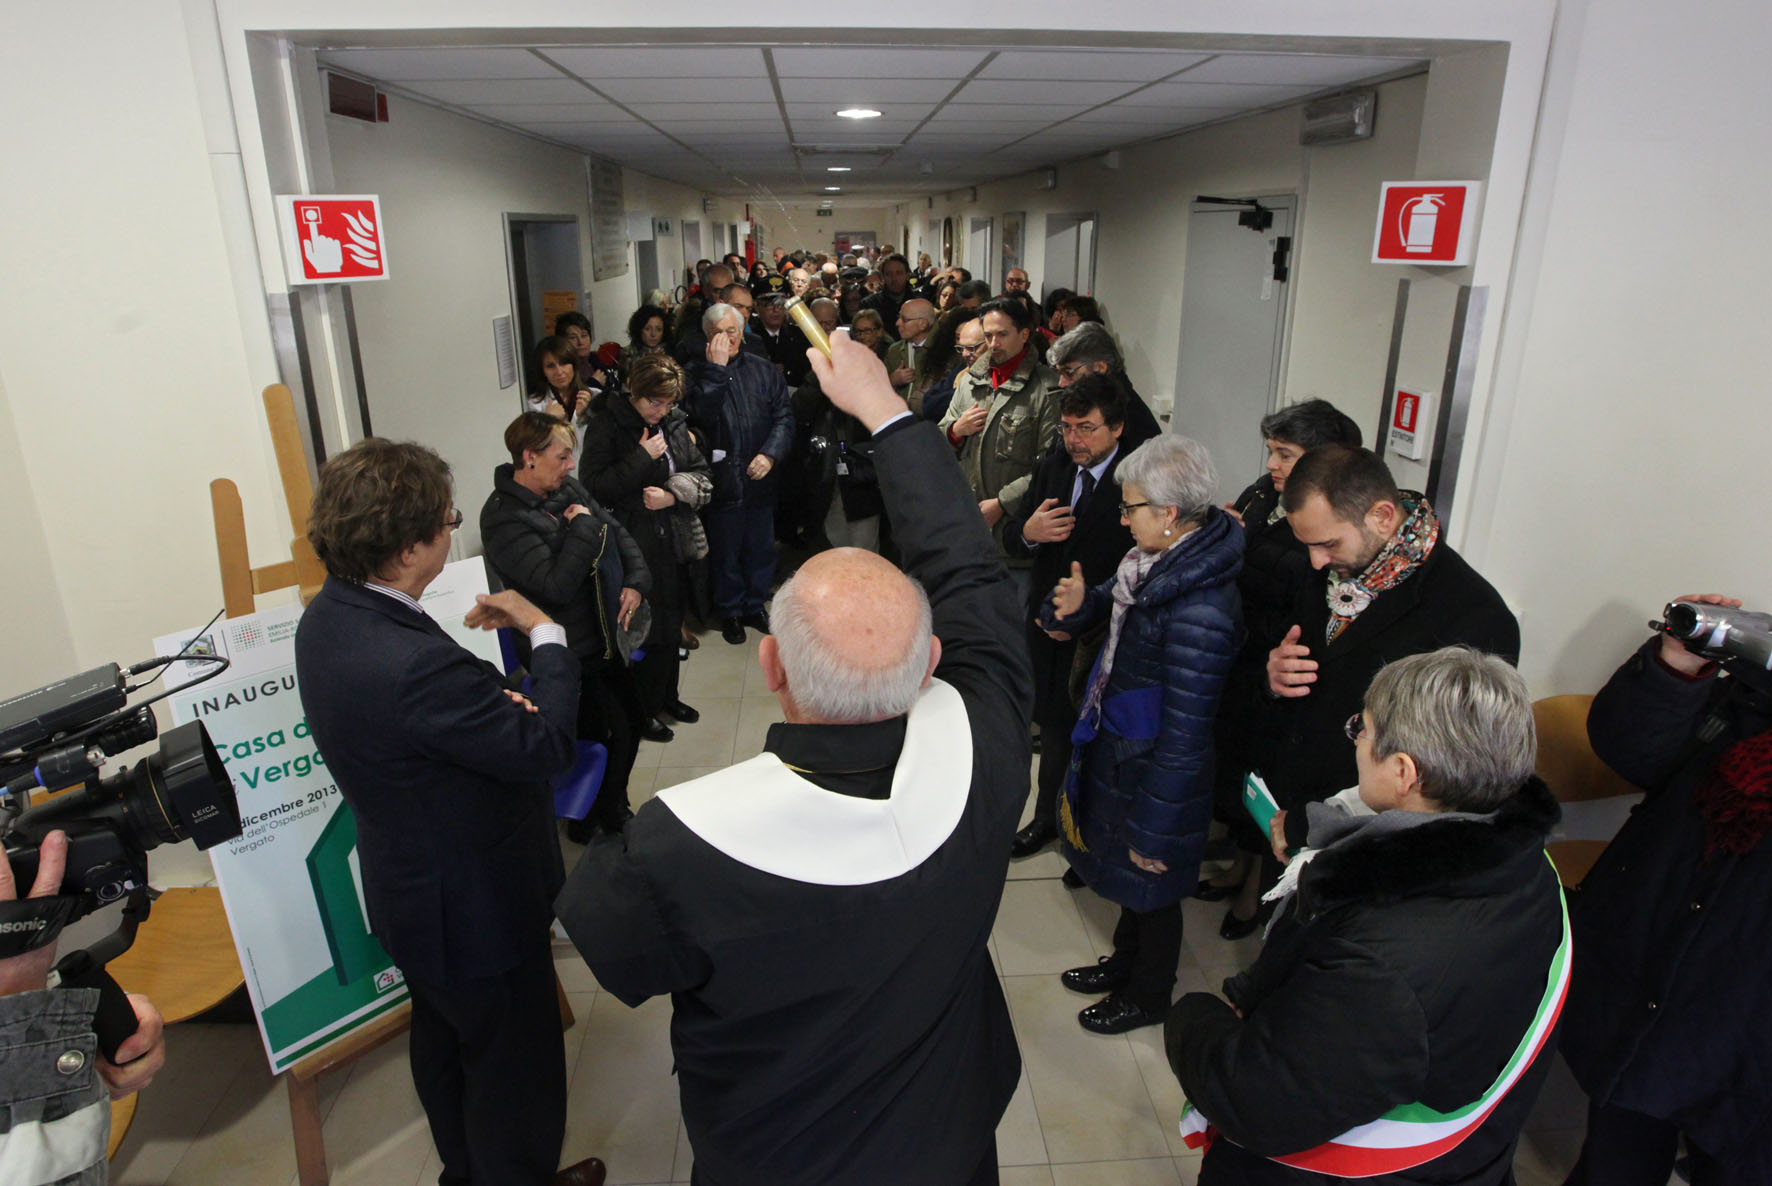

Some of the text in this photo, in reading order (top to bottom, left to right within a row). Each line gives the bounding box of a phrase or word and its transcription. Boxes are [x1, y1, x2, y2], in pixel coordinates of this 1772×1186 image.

[192, 675, 295, 718] INAUGU
[215, 729, 286, 765] Casa
[240, 751, 325, 790] Verga
[191, 804, 217, 818] LEICA
[241, 784, 338, 829] dicembre 2013
[230, 835, 275, 857] Vergato
[0, 917, 47, 934] sonic
